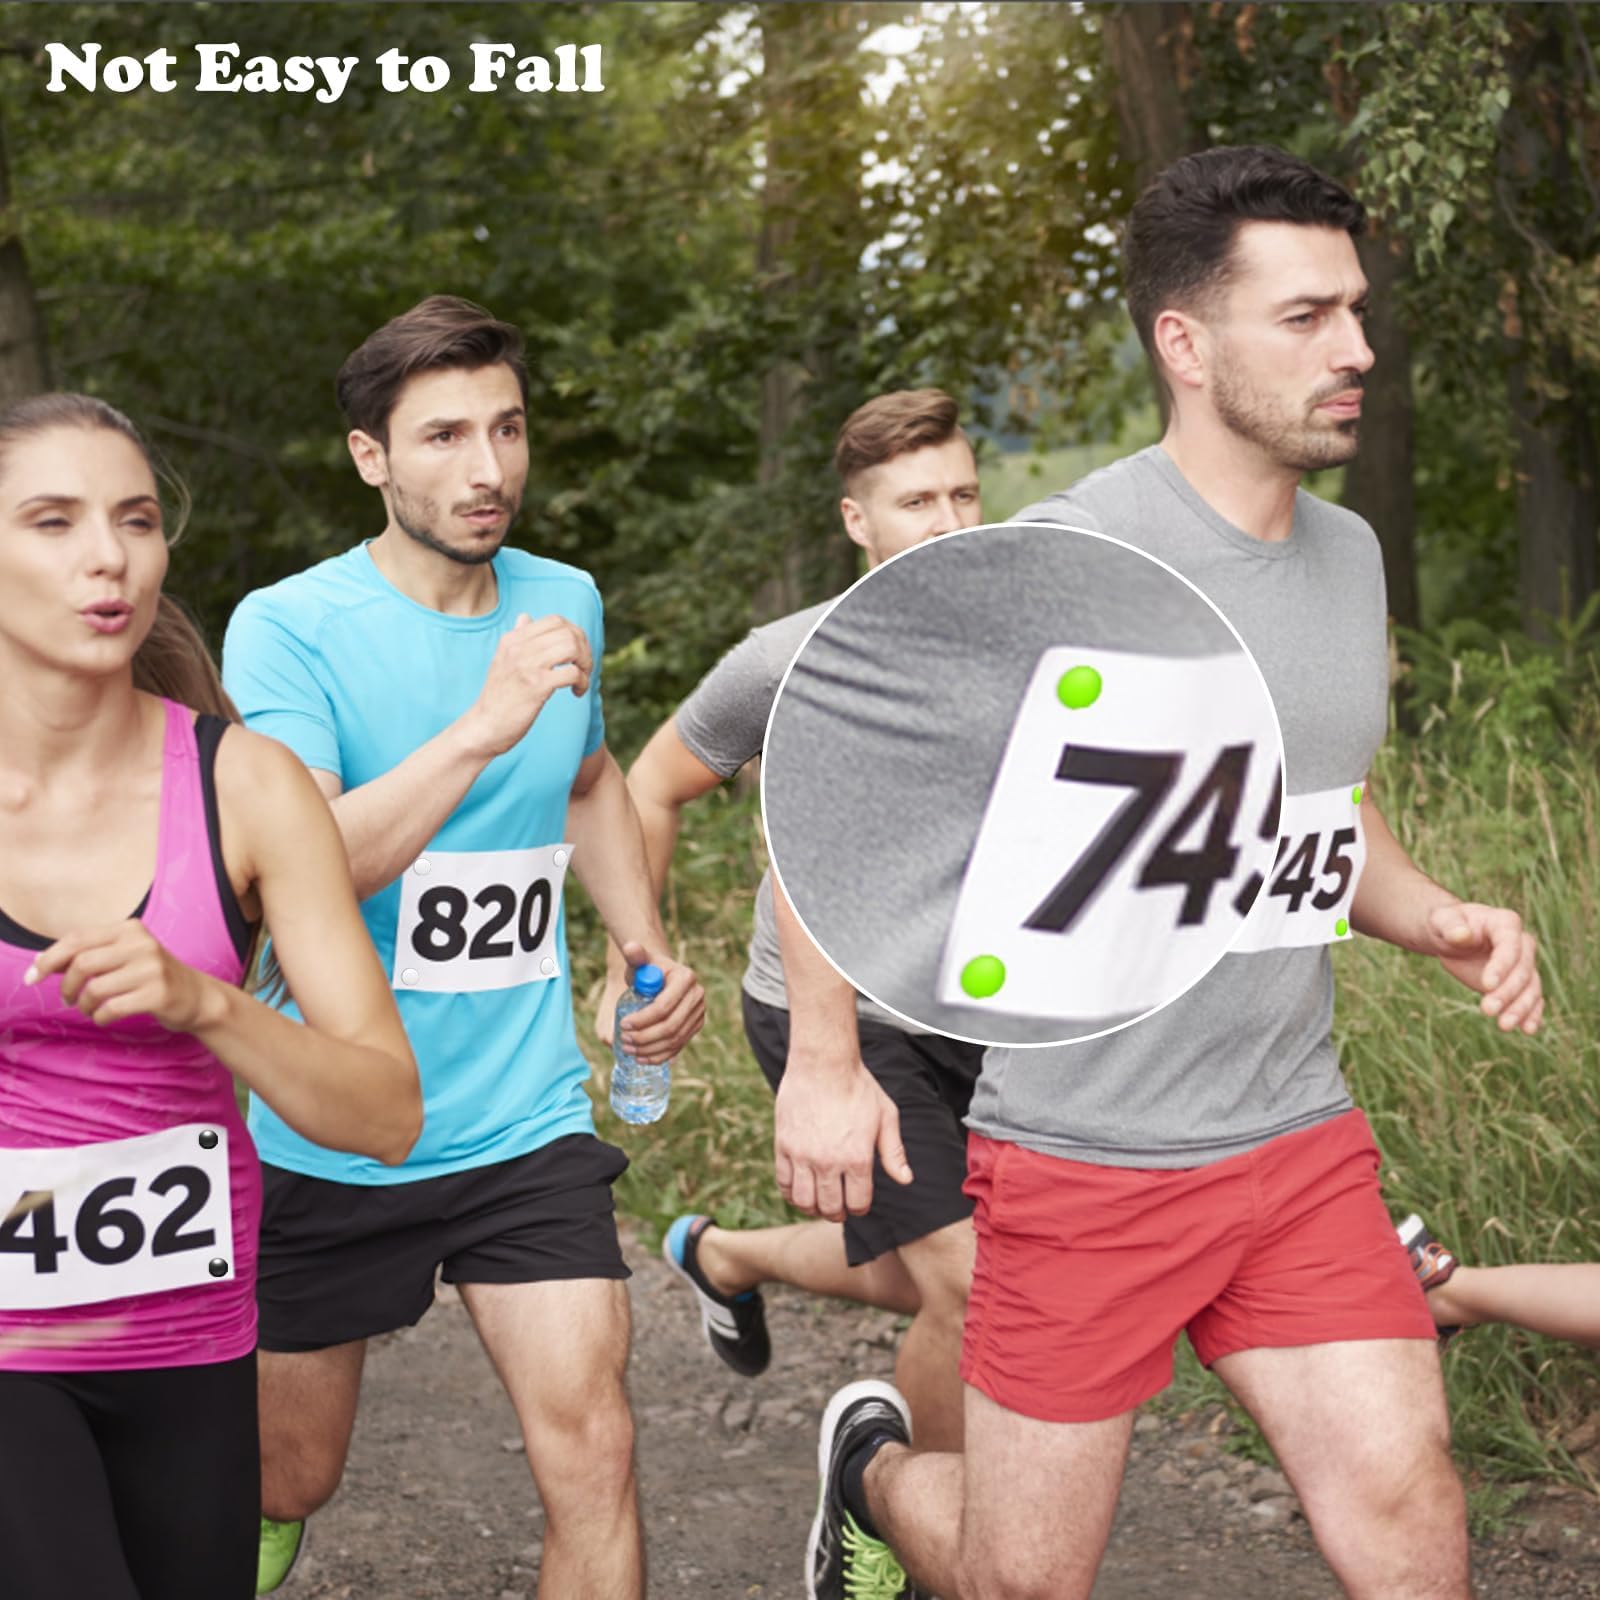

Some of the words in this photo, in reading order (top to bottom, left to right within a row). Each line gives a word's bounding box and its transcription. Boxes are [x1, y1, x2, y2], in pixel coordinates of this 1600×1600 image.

[1269, 826, 1357, 915] 45
[411, 877, 553, 962] 820
[0, 1165, 216, 1274] 462
